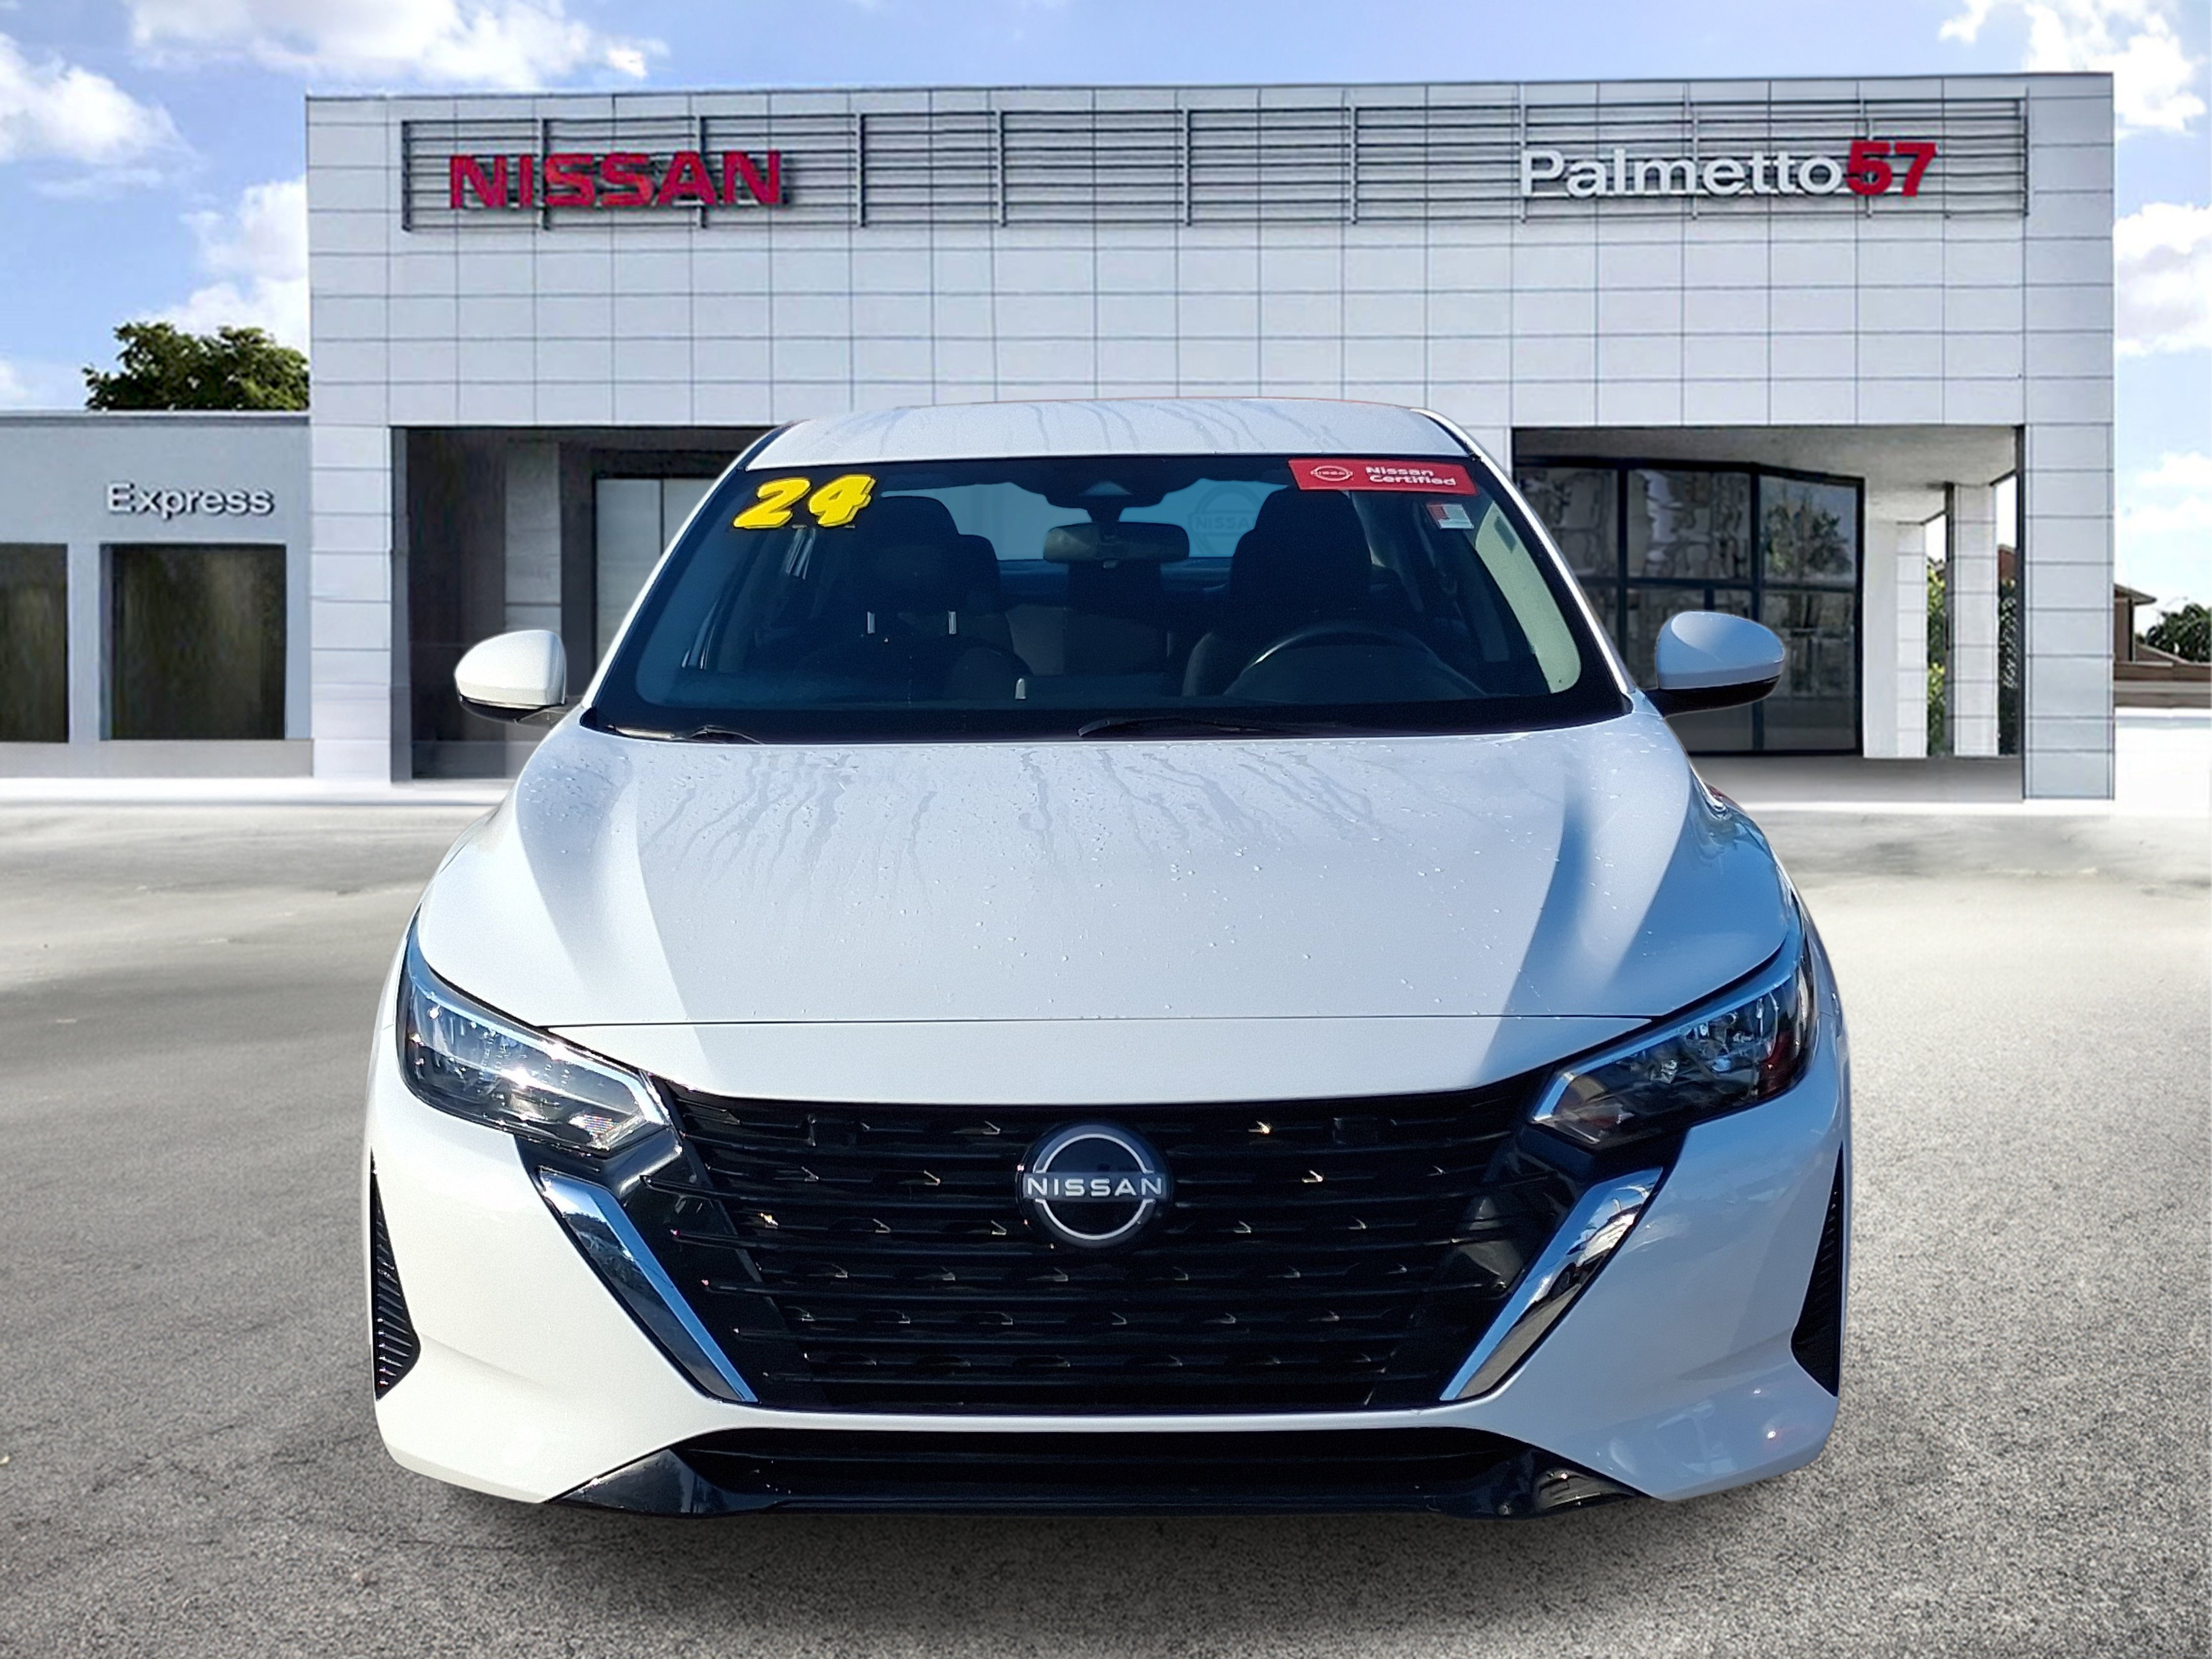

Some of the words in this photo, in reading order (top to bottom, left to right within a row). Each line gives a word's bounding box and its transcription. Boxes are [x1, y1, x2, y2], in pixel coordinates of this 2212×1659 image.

[449, 150, 781, 209] NISSAN
[1365, 466, 1434, 476] Nissan
[1369, 475, 1456, 486] Certified
[107, 481, 275, 520] Express
[732, 473, 877, 529] 24
[1195, 516, 1256, 530] NISSA
[1027, 1177, 1162, 1197] NISSAN
